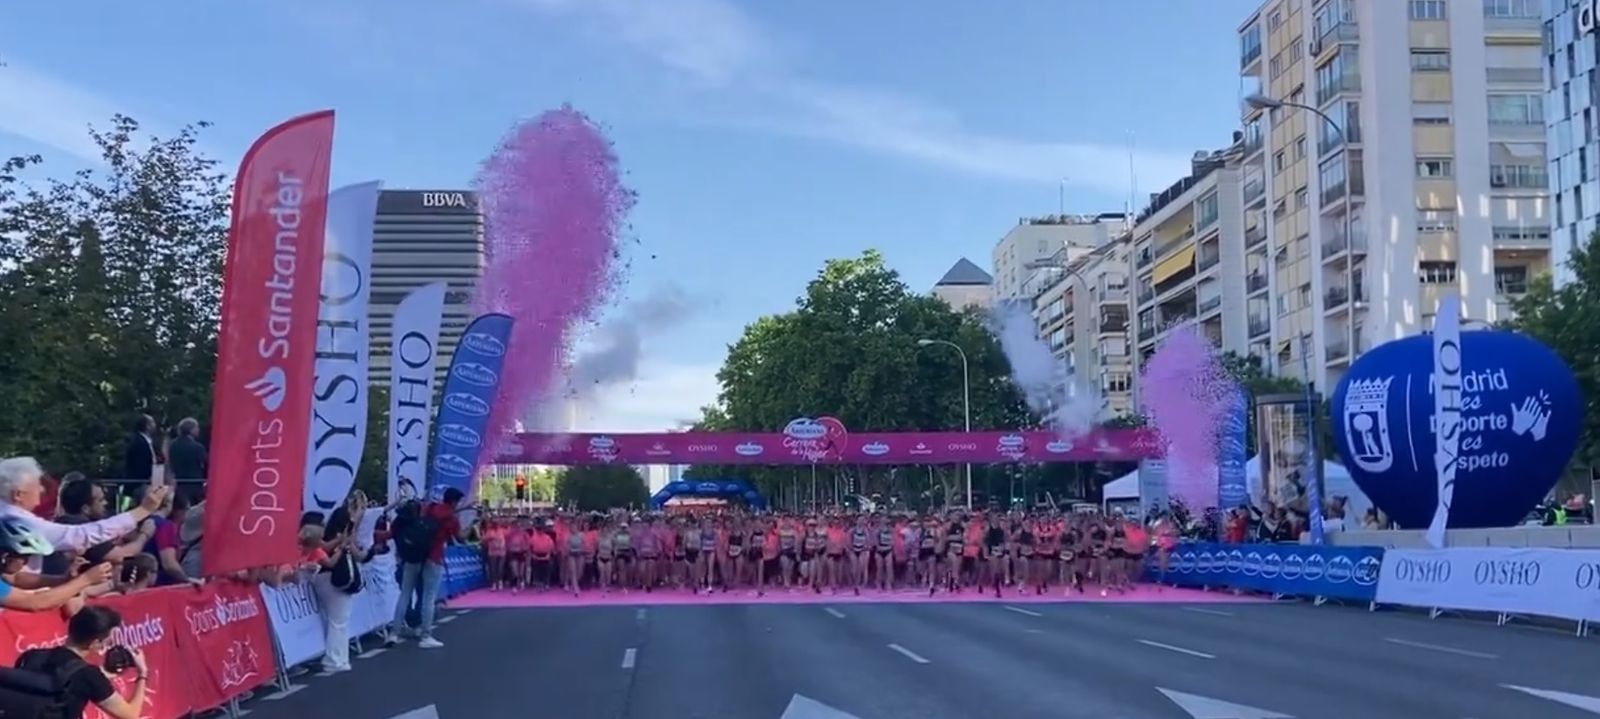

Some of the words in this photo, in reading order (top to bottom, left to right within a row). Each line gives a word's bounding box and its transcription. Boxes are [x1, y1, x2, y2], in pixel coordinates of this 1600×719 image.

[423, 192, 466, 207] BBVA
[258, 170, 304, 359] Santander
[1429, 368, 1509, 394] drid
[1461, 394, 1483, 412] es
[1462, 434, 1484, 451] es
[239, 417, 284, 537] Sports
[1395, 558, 1451, 583] OYSHO
[1473, 560, 1540, 586] OYSHO
